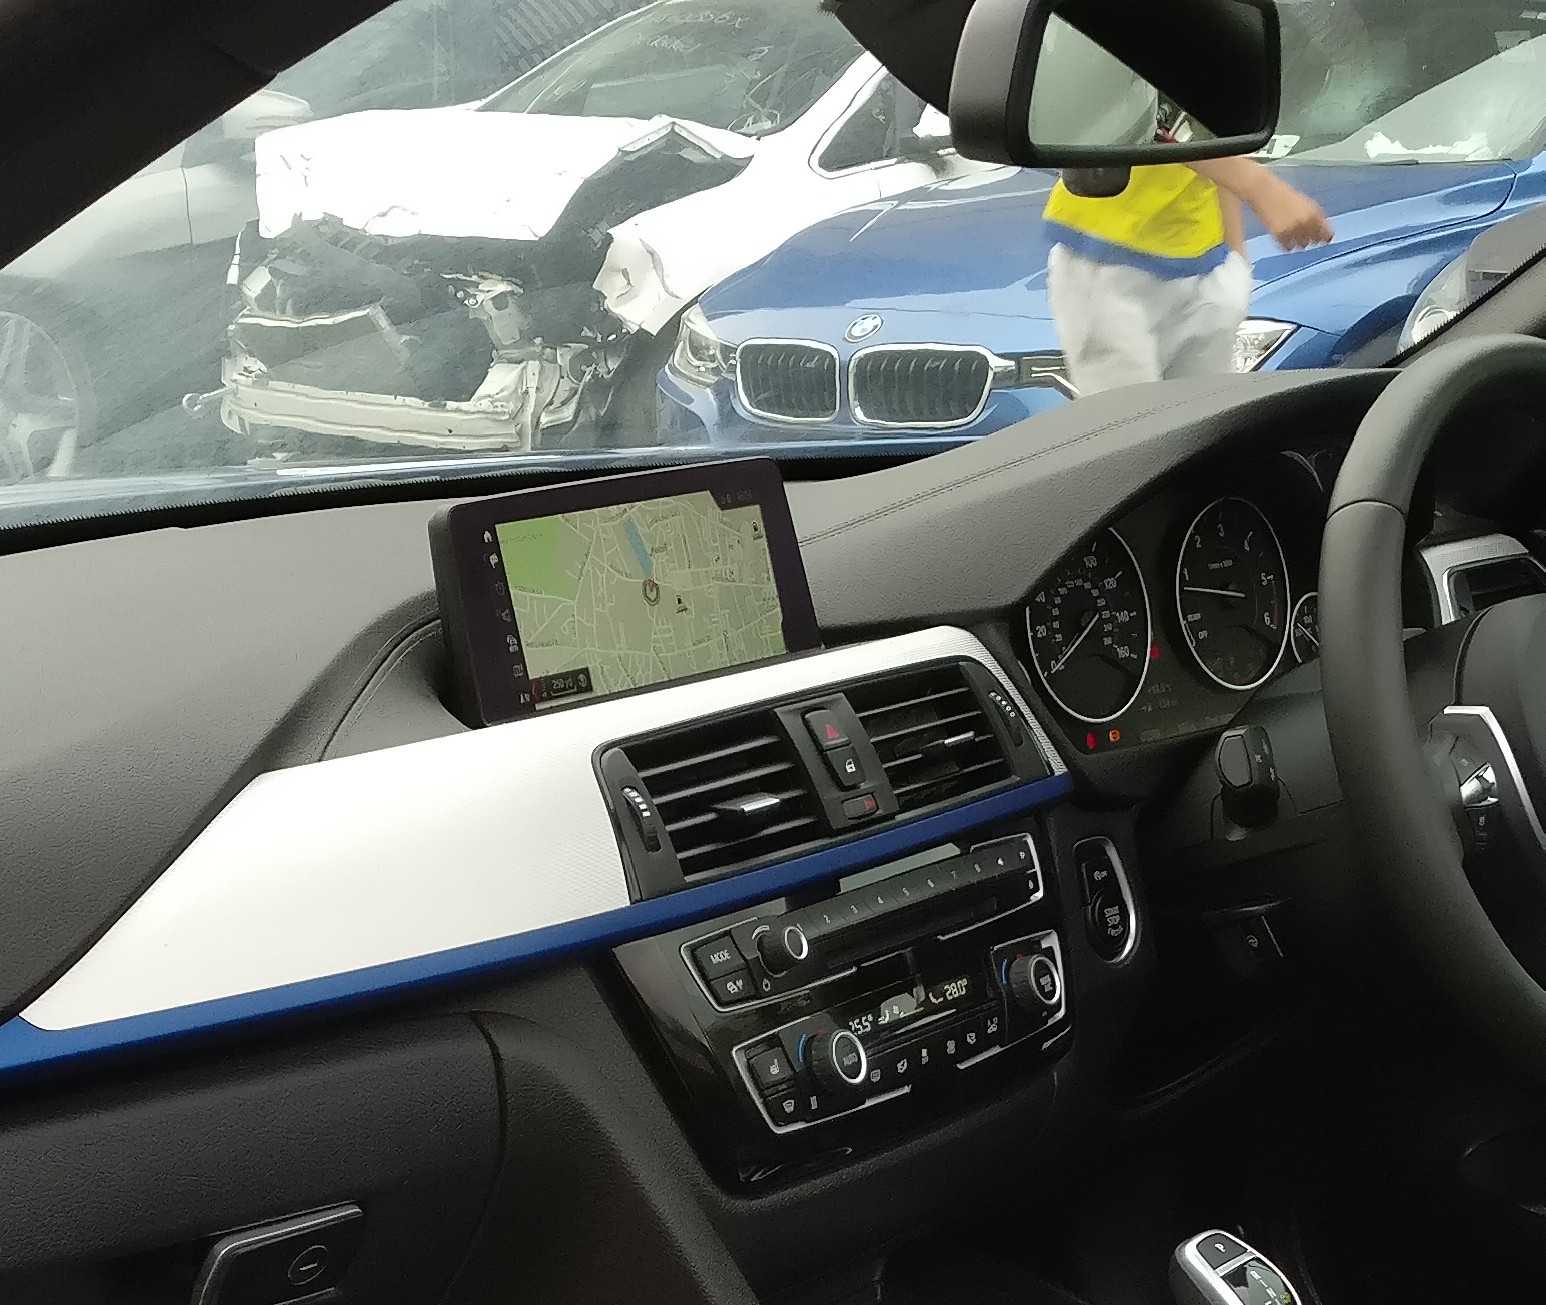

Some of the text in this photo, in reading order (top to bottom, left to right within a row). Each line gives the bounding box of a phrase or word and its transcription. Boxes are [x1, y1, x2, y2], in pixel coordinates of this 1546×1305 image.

[1194, 534, 1202, 549] 2
[1035, 624, 1047, 638] 20
[710, 949, 732, 965] MODE
